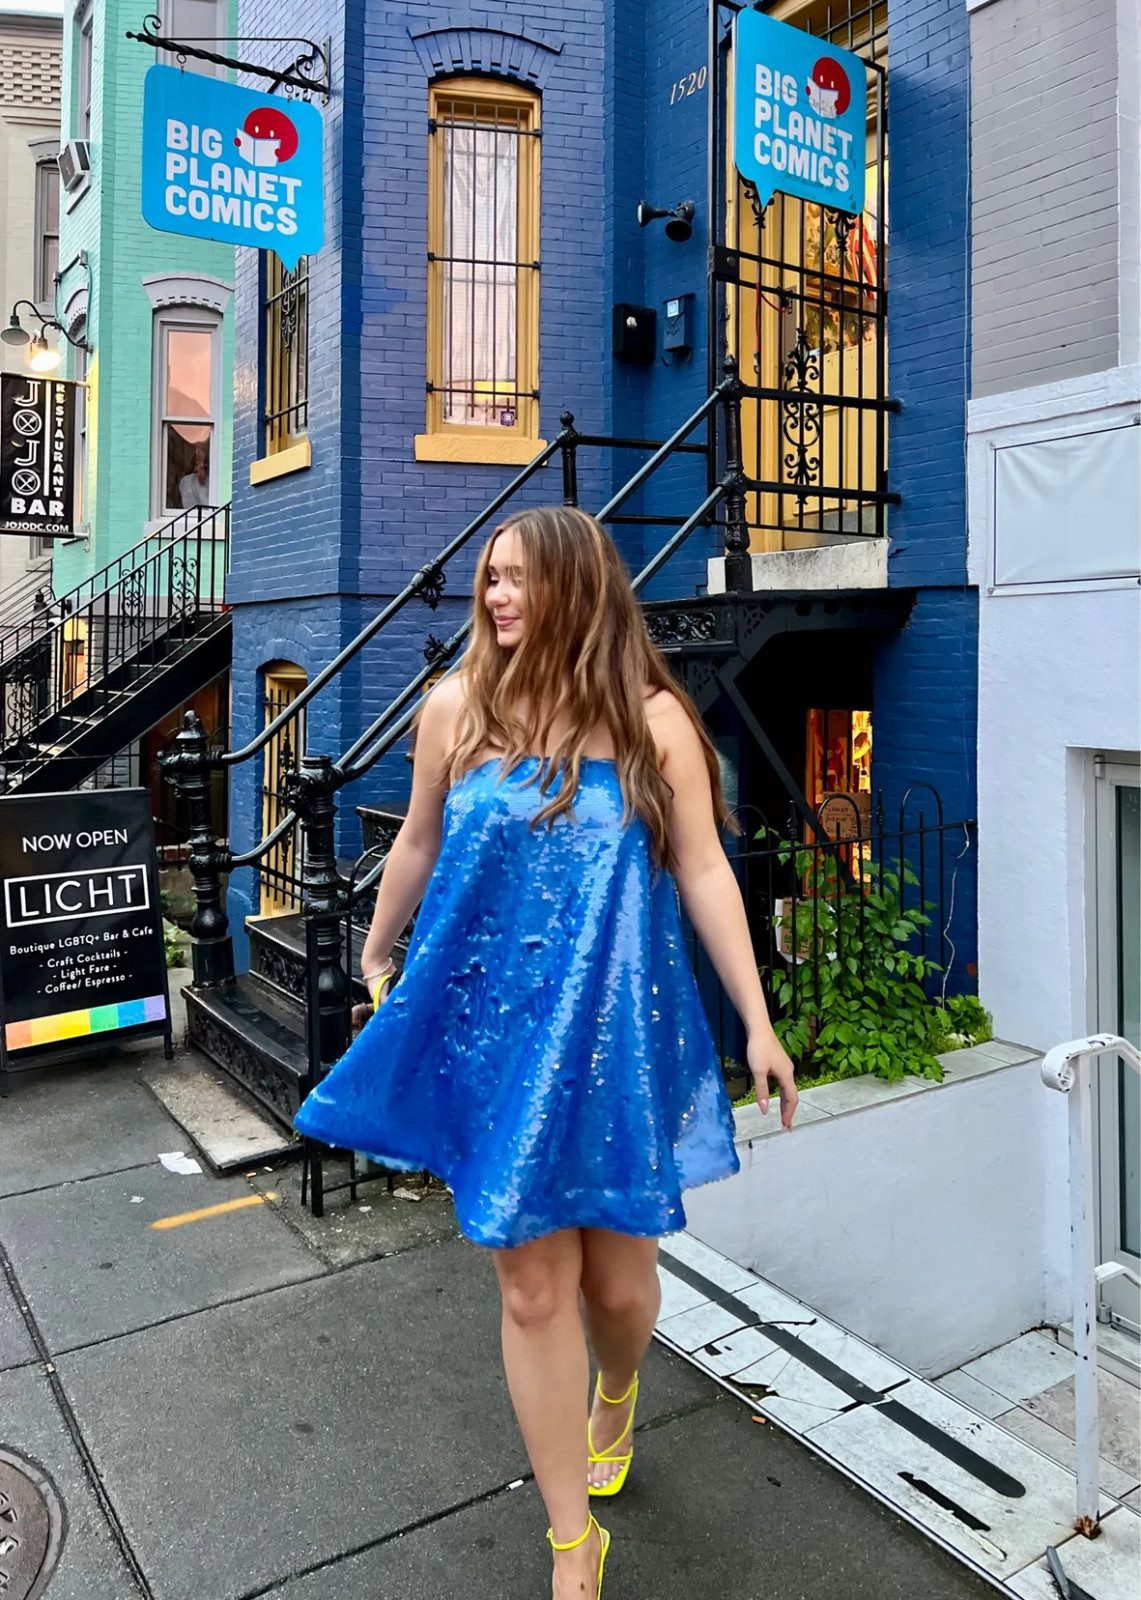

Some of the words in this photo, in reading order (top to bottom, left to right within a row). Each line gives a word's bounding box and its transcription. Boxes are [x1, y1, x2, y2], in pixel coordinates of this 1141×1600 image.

[669, 66, 707, 106] 1520
[755, 63, 797, 107] BIG
[166, 118, 223, 159] BIG
[754, 98, 853, 160] PLANET
[166, 152, 302, 205] PLANET
[754, 132, 850, 193] COMICS
[165, 185, 298, 236] COMICS
[52, 382, 66, 498] RESTAURANT
[4, 521, 69, 533] JOJODC.COM
[10, 497, 65, 517] BAR
[22, 833, 72, 853] NOW
[76, 828, 128, 848] OPEN
[19, 873, 137, 917] LICHT
[9, 942, 56, 956] Boutique
[58, 934, 100, 948] LGBTQ+
[103, 931, 119, 942] Bar
[122, 929, 129, 939] &
[132, 926, 153, 937] Cafe
[47, 956, 74, 968] Craft
[77, 949, 121, 964] Cocktails
[60, 966, 86, 981] Light
[89, 963, 110, 974] Fare
[85, 974, 126, 988] Espresso
